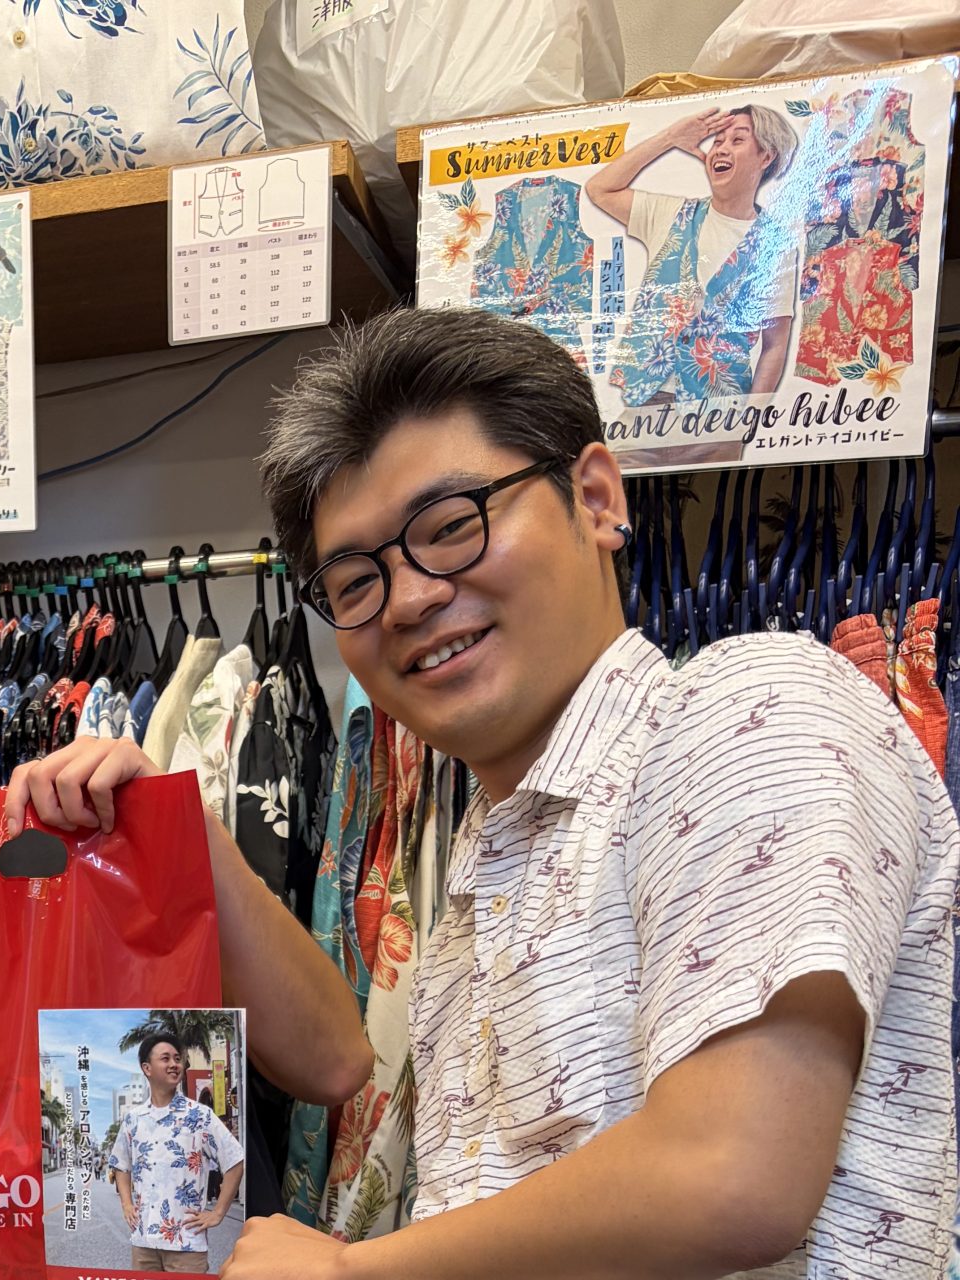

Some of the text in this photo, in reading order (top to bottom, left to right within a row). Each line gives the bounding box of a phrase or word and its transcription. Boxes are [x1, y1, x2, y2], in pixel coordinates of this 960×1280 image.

[446, 131, 623, 179] Summer Vest
[680, 397, 787, 444] deigo
[790, 386, 902, 428] hibee
[14, 1213, 34, 1228] IN
